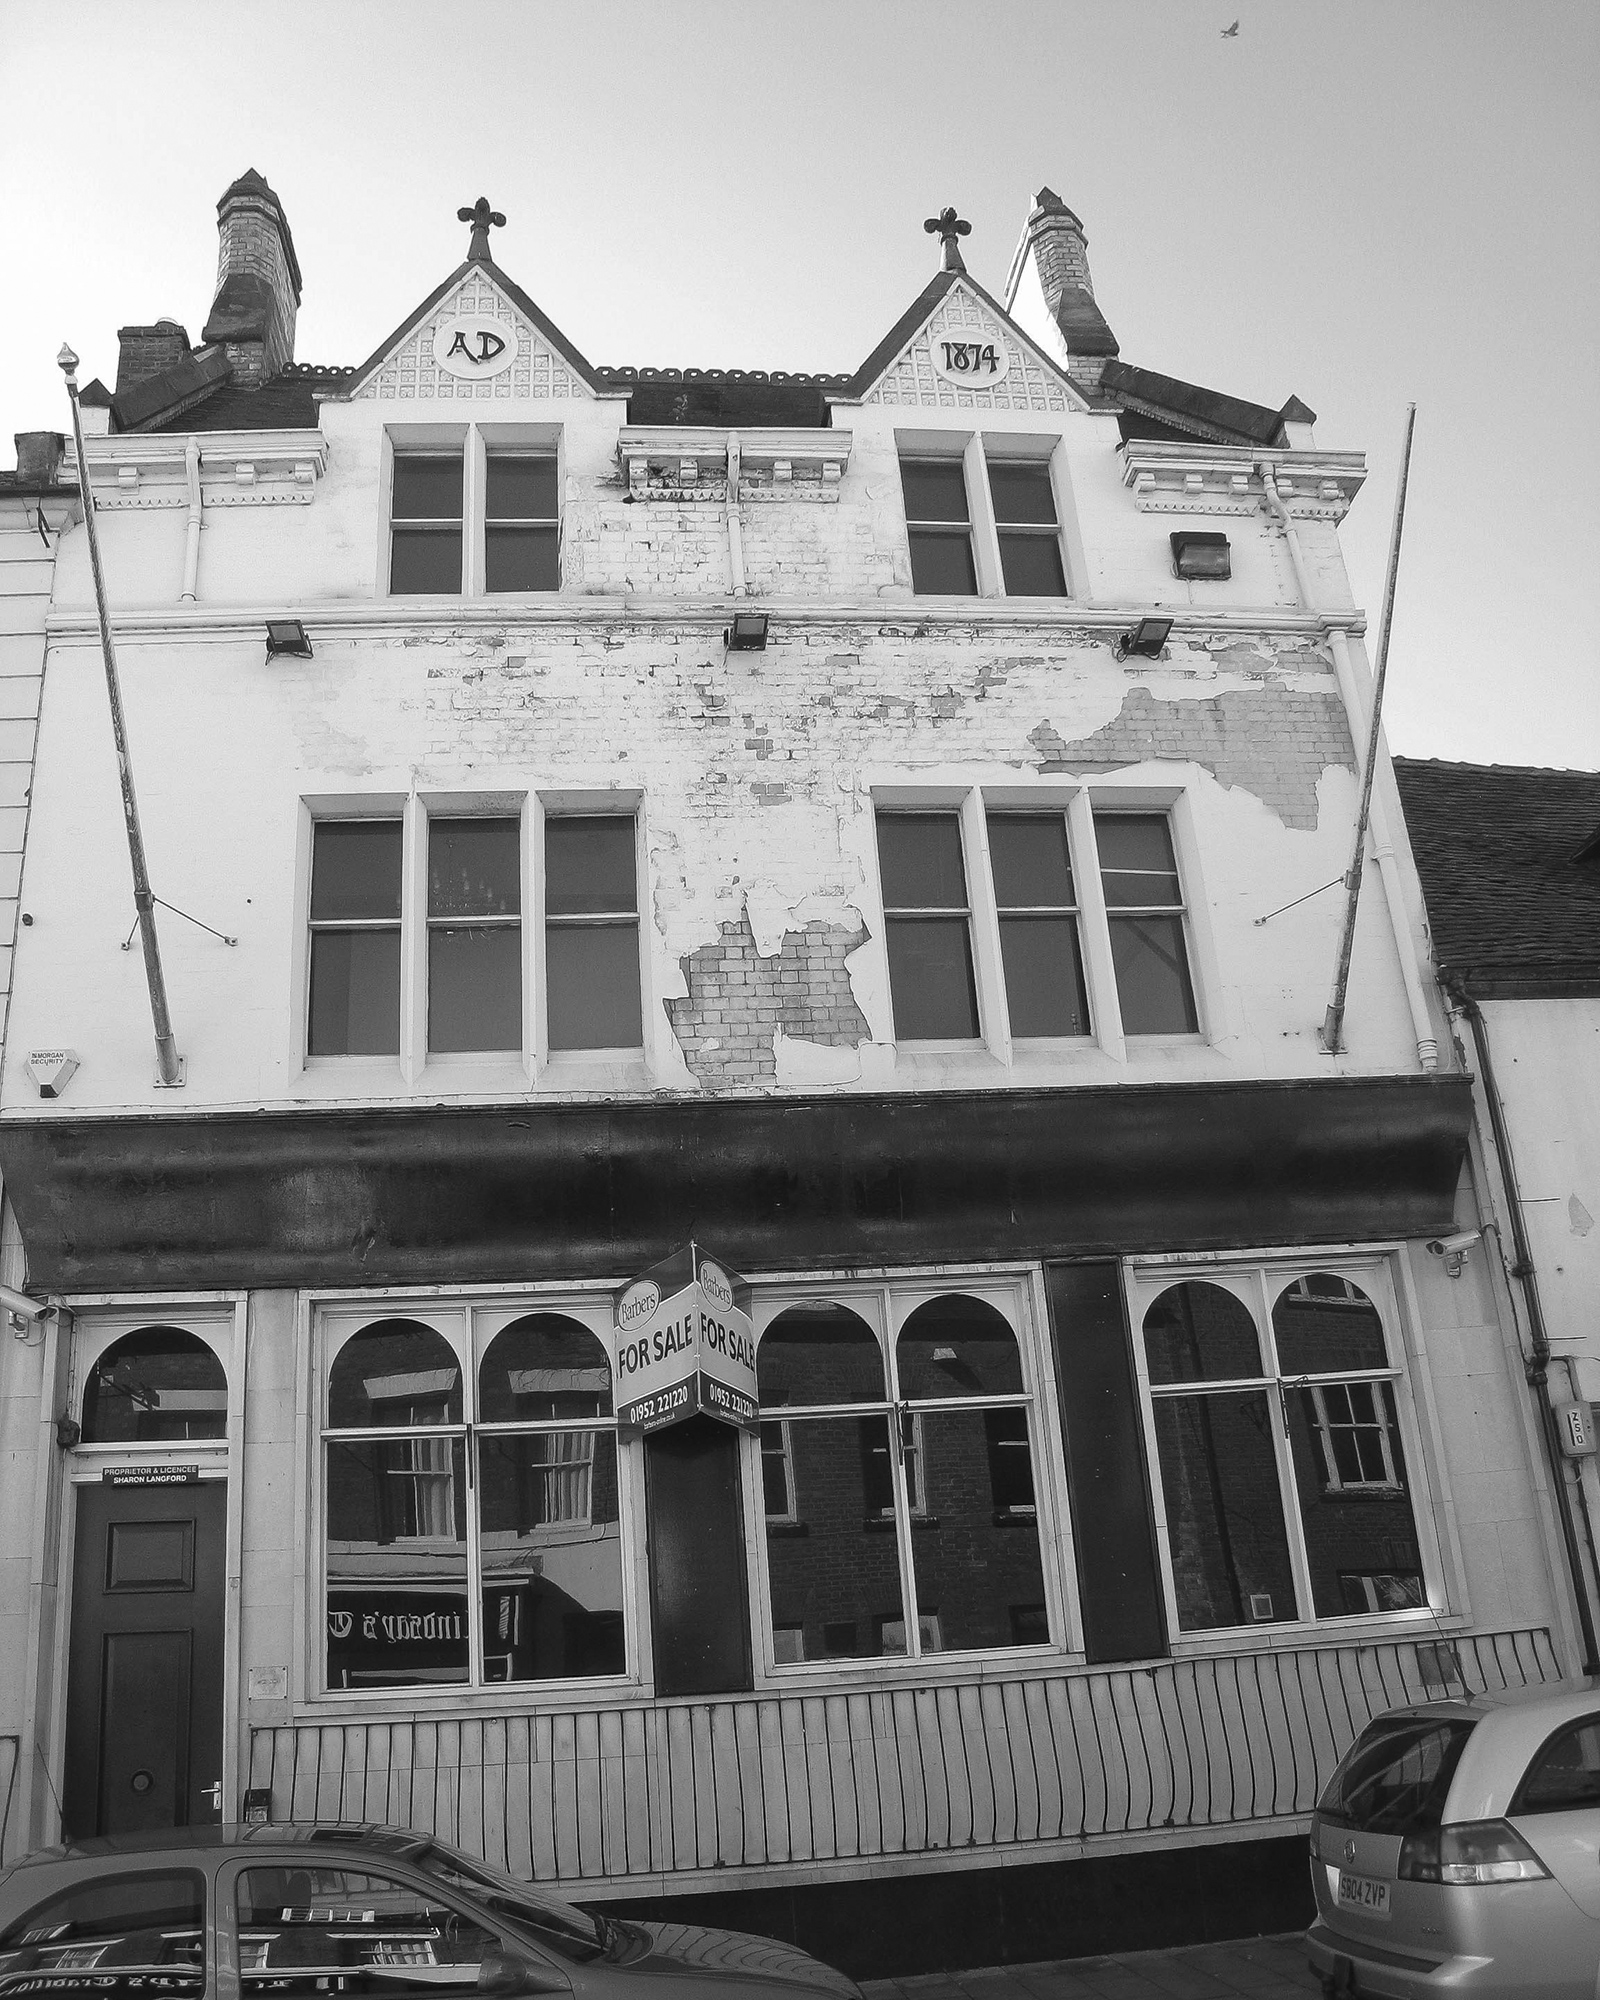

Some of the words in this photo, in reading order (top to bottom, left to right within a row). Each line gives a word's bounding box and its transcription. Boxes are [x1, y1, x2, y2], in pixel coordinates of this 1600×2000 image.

[941, 340, 1001, 375] 1874
[702, 1269, 732, 1305] Barbers
[621, 1292, 656, 1324] Barbers
[618, 1338, 651, 1379] FOR
[653, 1313, 693, 1362] SALE
[700, 1311, 728, 1355] FOR
[728, 1330, 755, 1373] SALE
[630, 1402, 655, 1424] 01952
[657, 1385, 688, 1414] 221220
[710, 1383, 730, 1409] 01952
[732, 1394, 753, 1419] 221220
[104, 1468, 152, 1476] PROPRIETOR
[153, 1467, 160, 1475] &
[160, 1466, 197, 1474] LICENCEE
[113, 1476, 145, 1484] SHARON
[146, 1475, 187, 1483] LANGFORD
[1341, 1877, 1363, 1900] SB04
[1365, 1882, 1385, 1906] ZVP
